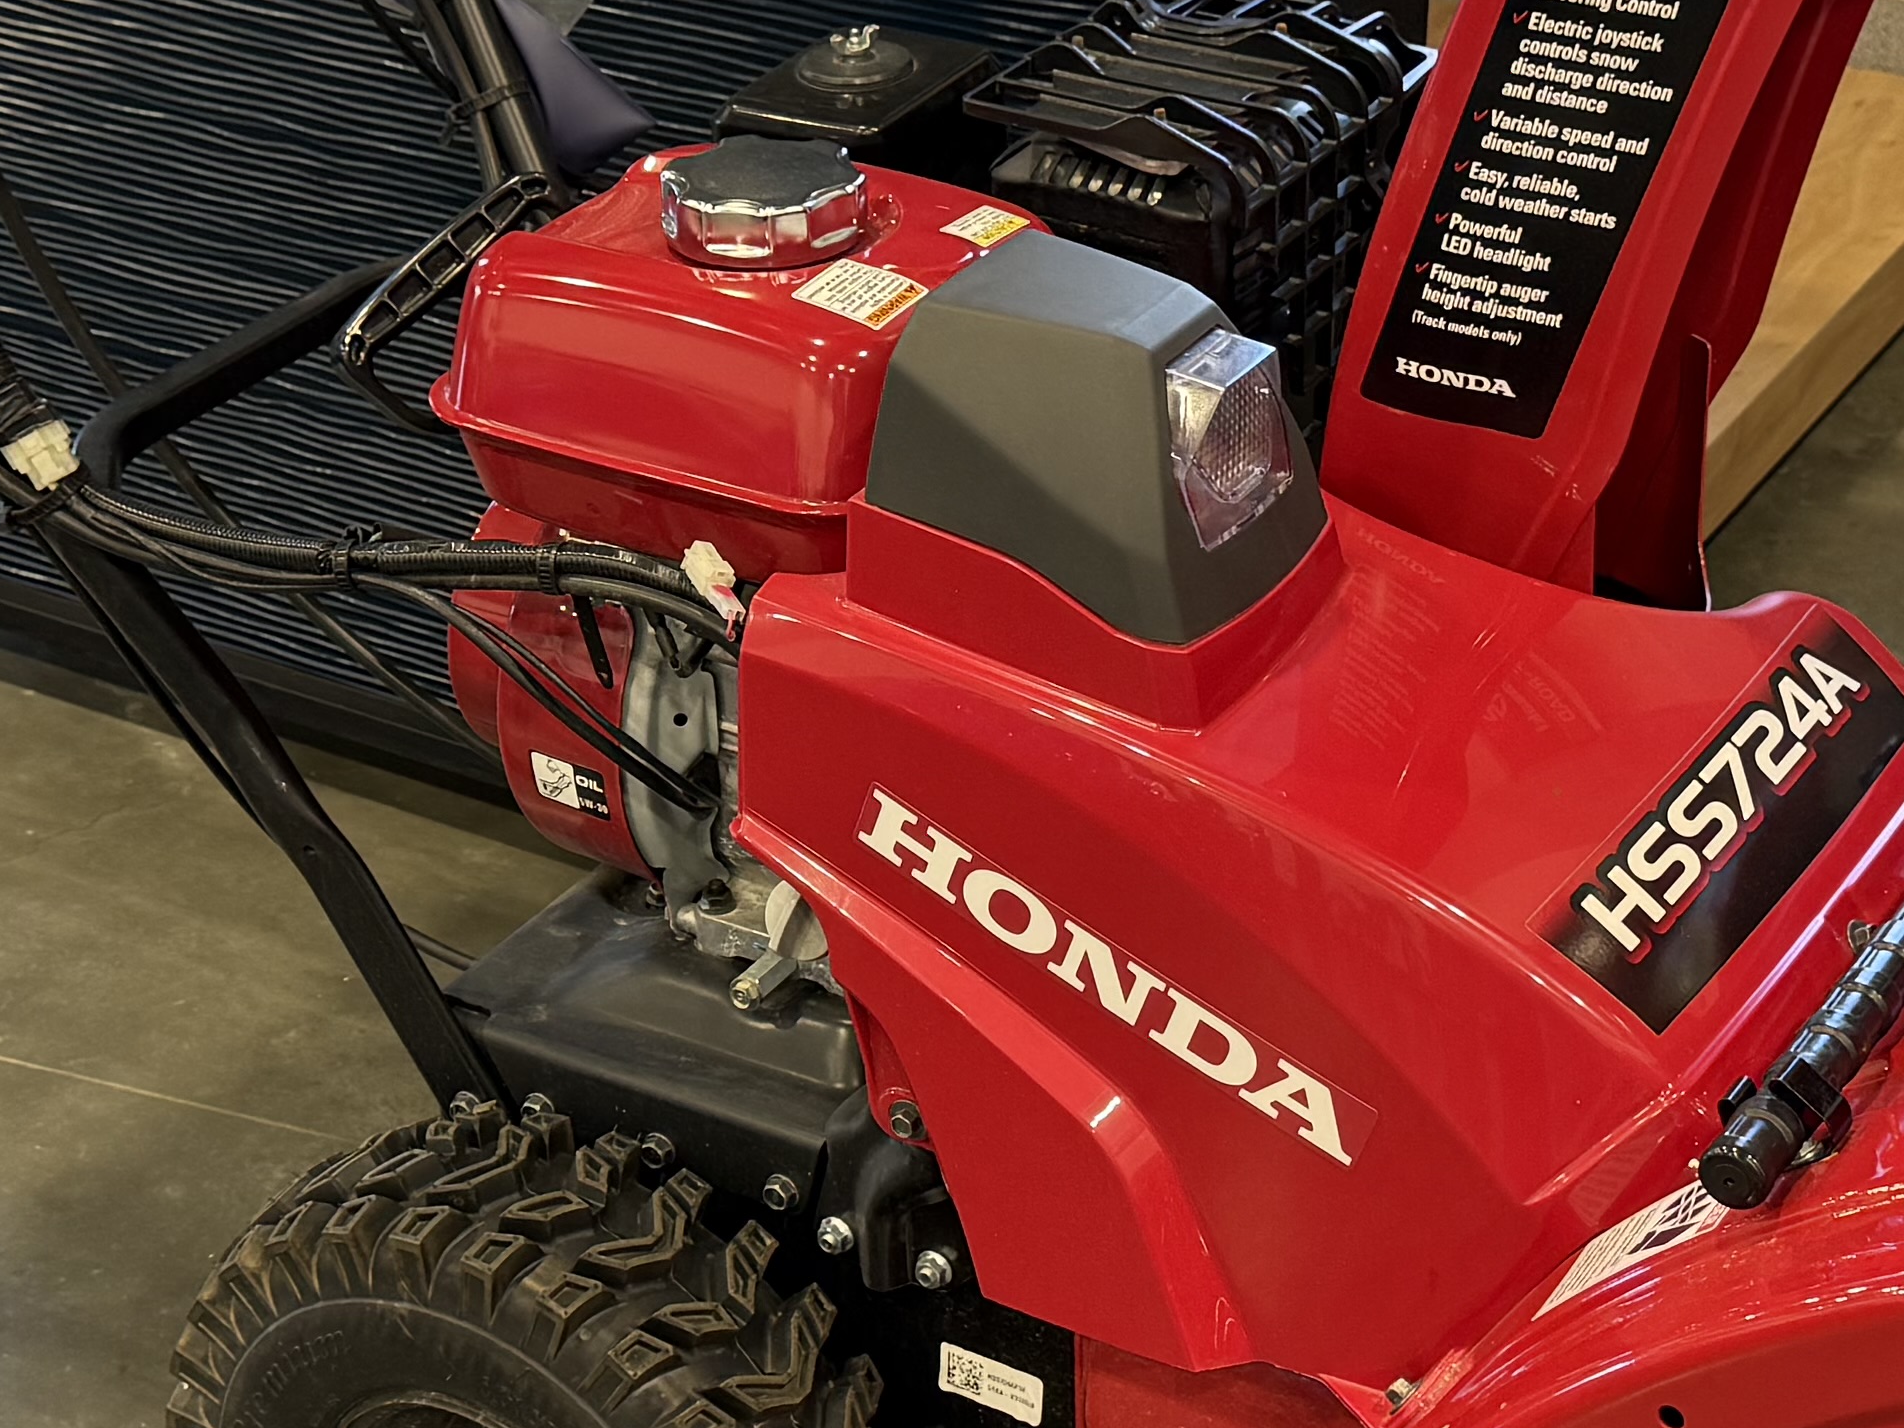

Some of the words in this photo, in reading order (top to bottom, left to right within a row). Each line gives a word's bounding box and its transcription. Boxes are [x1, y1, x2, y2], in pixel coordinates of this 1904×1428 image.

[1527, 11, 1593, 41] Electric
[1593, 23, 1665, 53] joystick
[1519, 38, 1588, 63] controls
[1589, 51, 1639, 72] snow
[1501, 82, 1535, 101] and
[1535, 86, 1608, 114] distance
[1510, 57, 1594, 90] discharge
[1596, 73, 1674, 102] direction
[1481, 131, 1555, 161] direction
[1556, 149, 1617, 173] control
[1490, 109, 1559, 138] Variable
[1561, 126, 1614, 148] speed
[1615, 137, 1650, 156] and
[1468, 161, 1509, 189] Easy,
[1512, 173, 1581, 201] reliable,
[1448, 212, 1523, 244] Powerful
[1460, 186, 1498, 207] cold
[1498, 194, 1568, 220] weather
[1569, 207, 1617, 230] starts
[1440, 233, 1472, 256] LED
[1473, 241, 1551, 272] headlight
[1429, 263, 1498, 297] Fingertip
[1500, 282, 1550, 303] auger
[1421, 283, 1470, 311] height
[1471, 299, 1564, 328] adjustment
[1411, 309, 1446, 330] (Track
[1447, 319, 1490, 339] models
[1491, 330, 1522, 346] only)
[1395, 356, 1516, 398] HONDA
[575, 774, 604, 793] OIL
[1580, 651, 1862, 952] HSS724A
[857, 788, 1353, 1167] HONDA
